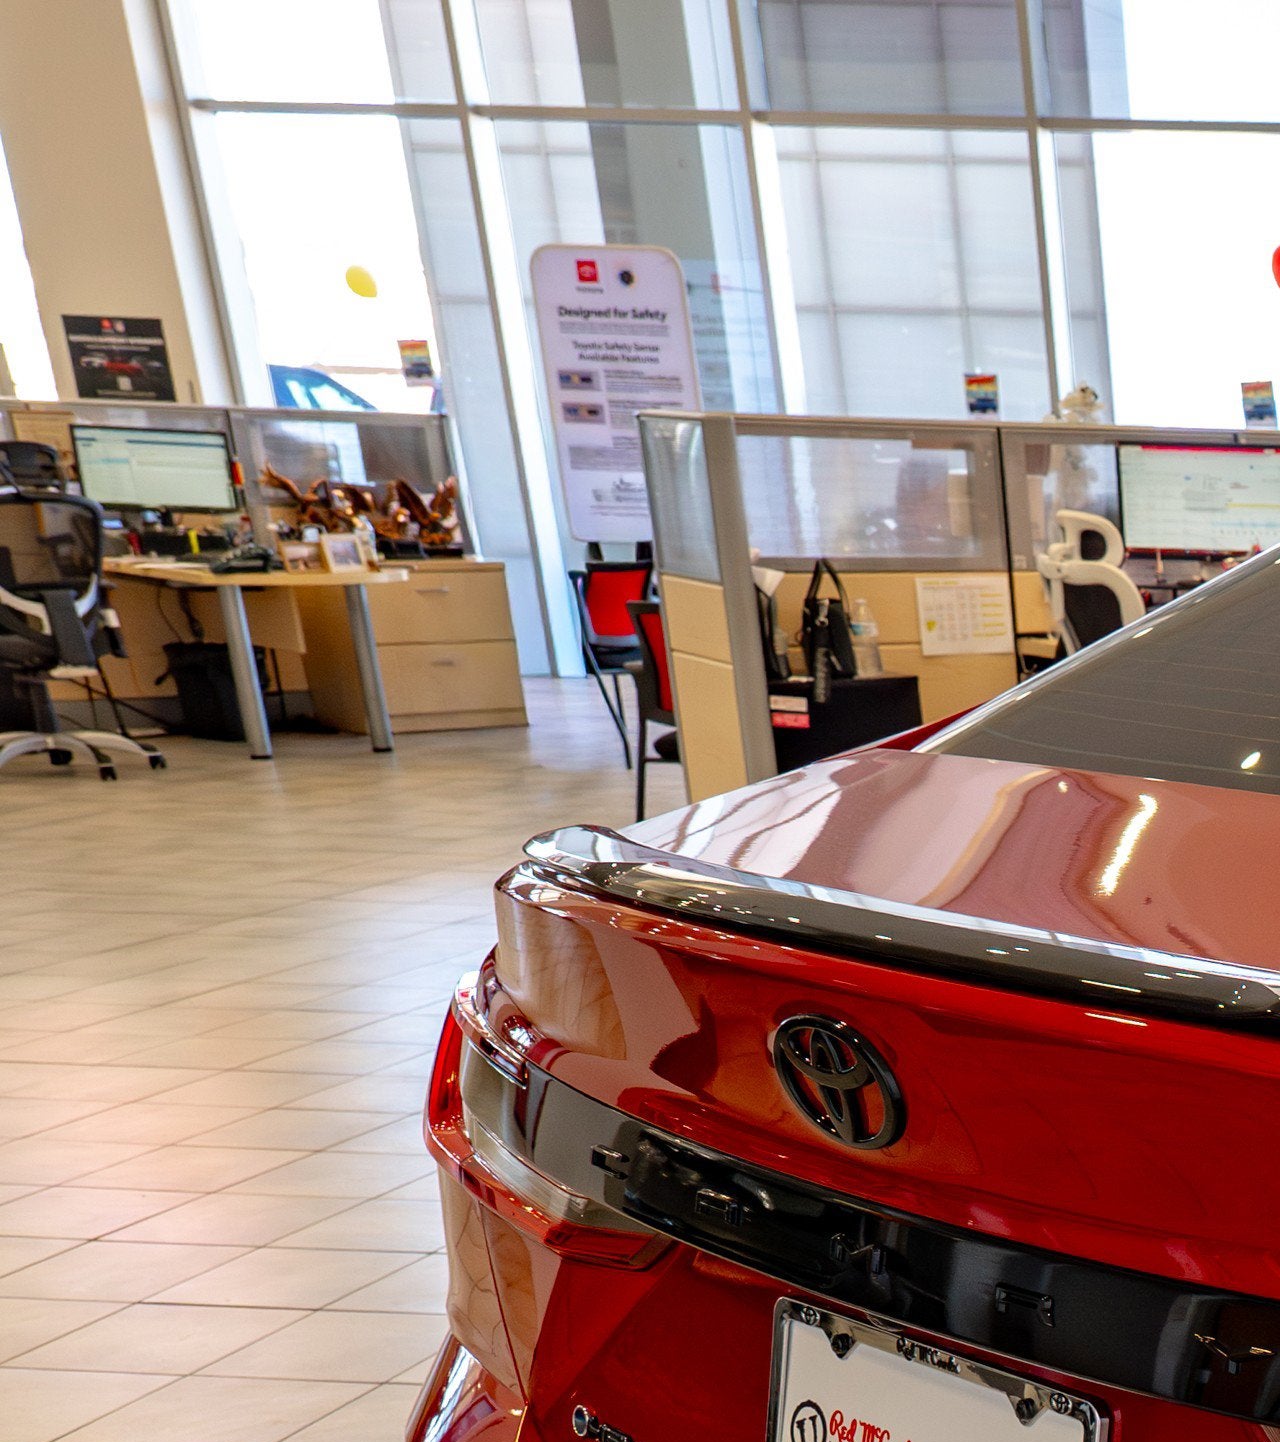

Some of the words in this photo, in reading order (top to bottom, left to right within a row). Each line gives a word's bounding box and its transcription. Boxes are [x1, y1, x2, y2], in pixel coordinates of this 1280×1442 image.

[558, 306, 611, 319] Designed
[613, 307, 628, 318] for
[631, 308, 667, 321] Safety
[604, 342, 632, 352] Safety
[578, 353, 619, 361] Available
[621, 354, 660, 364] Features
